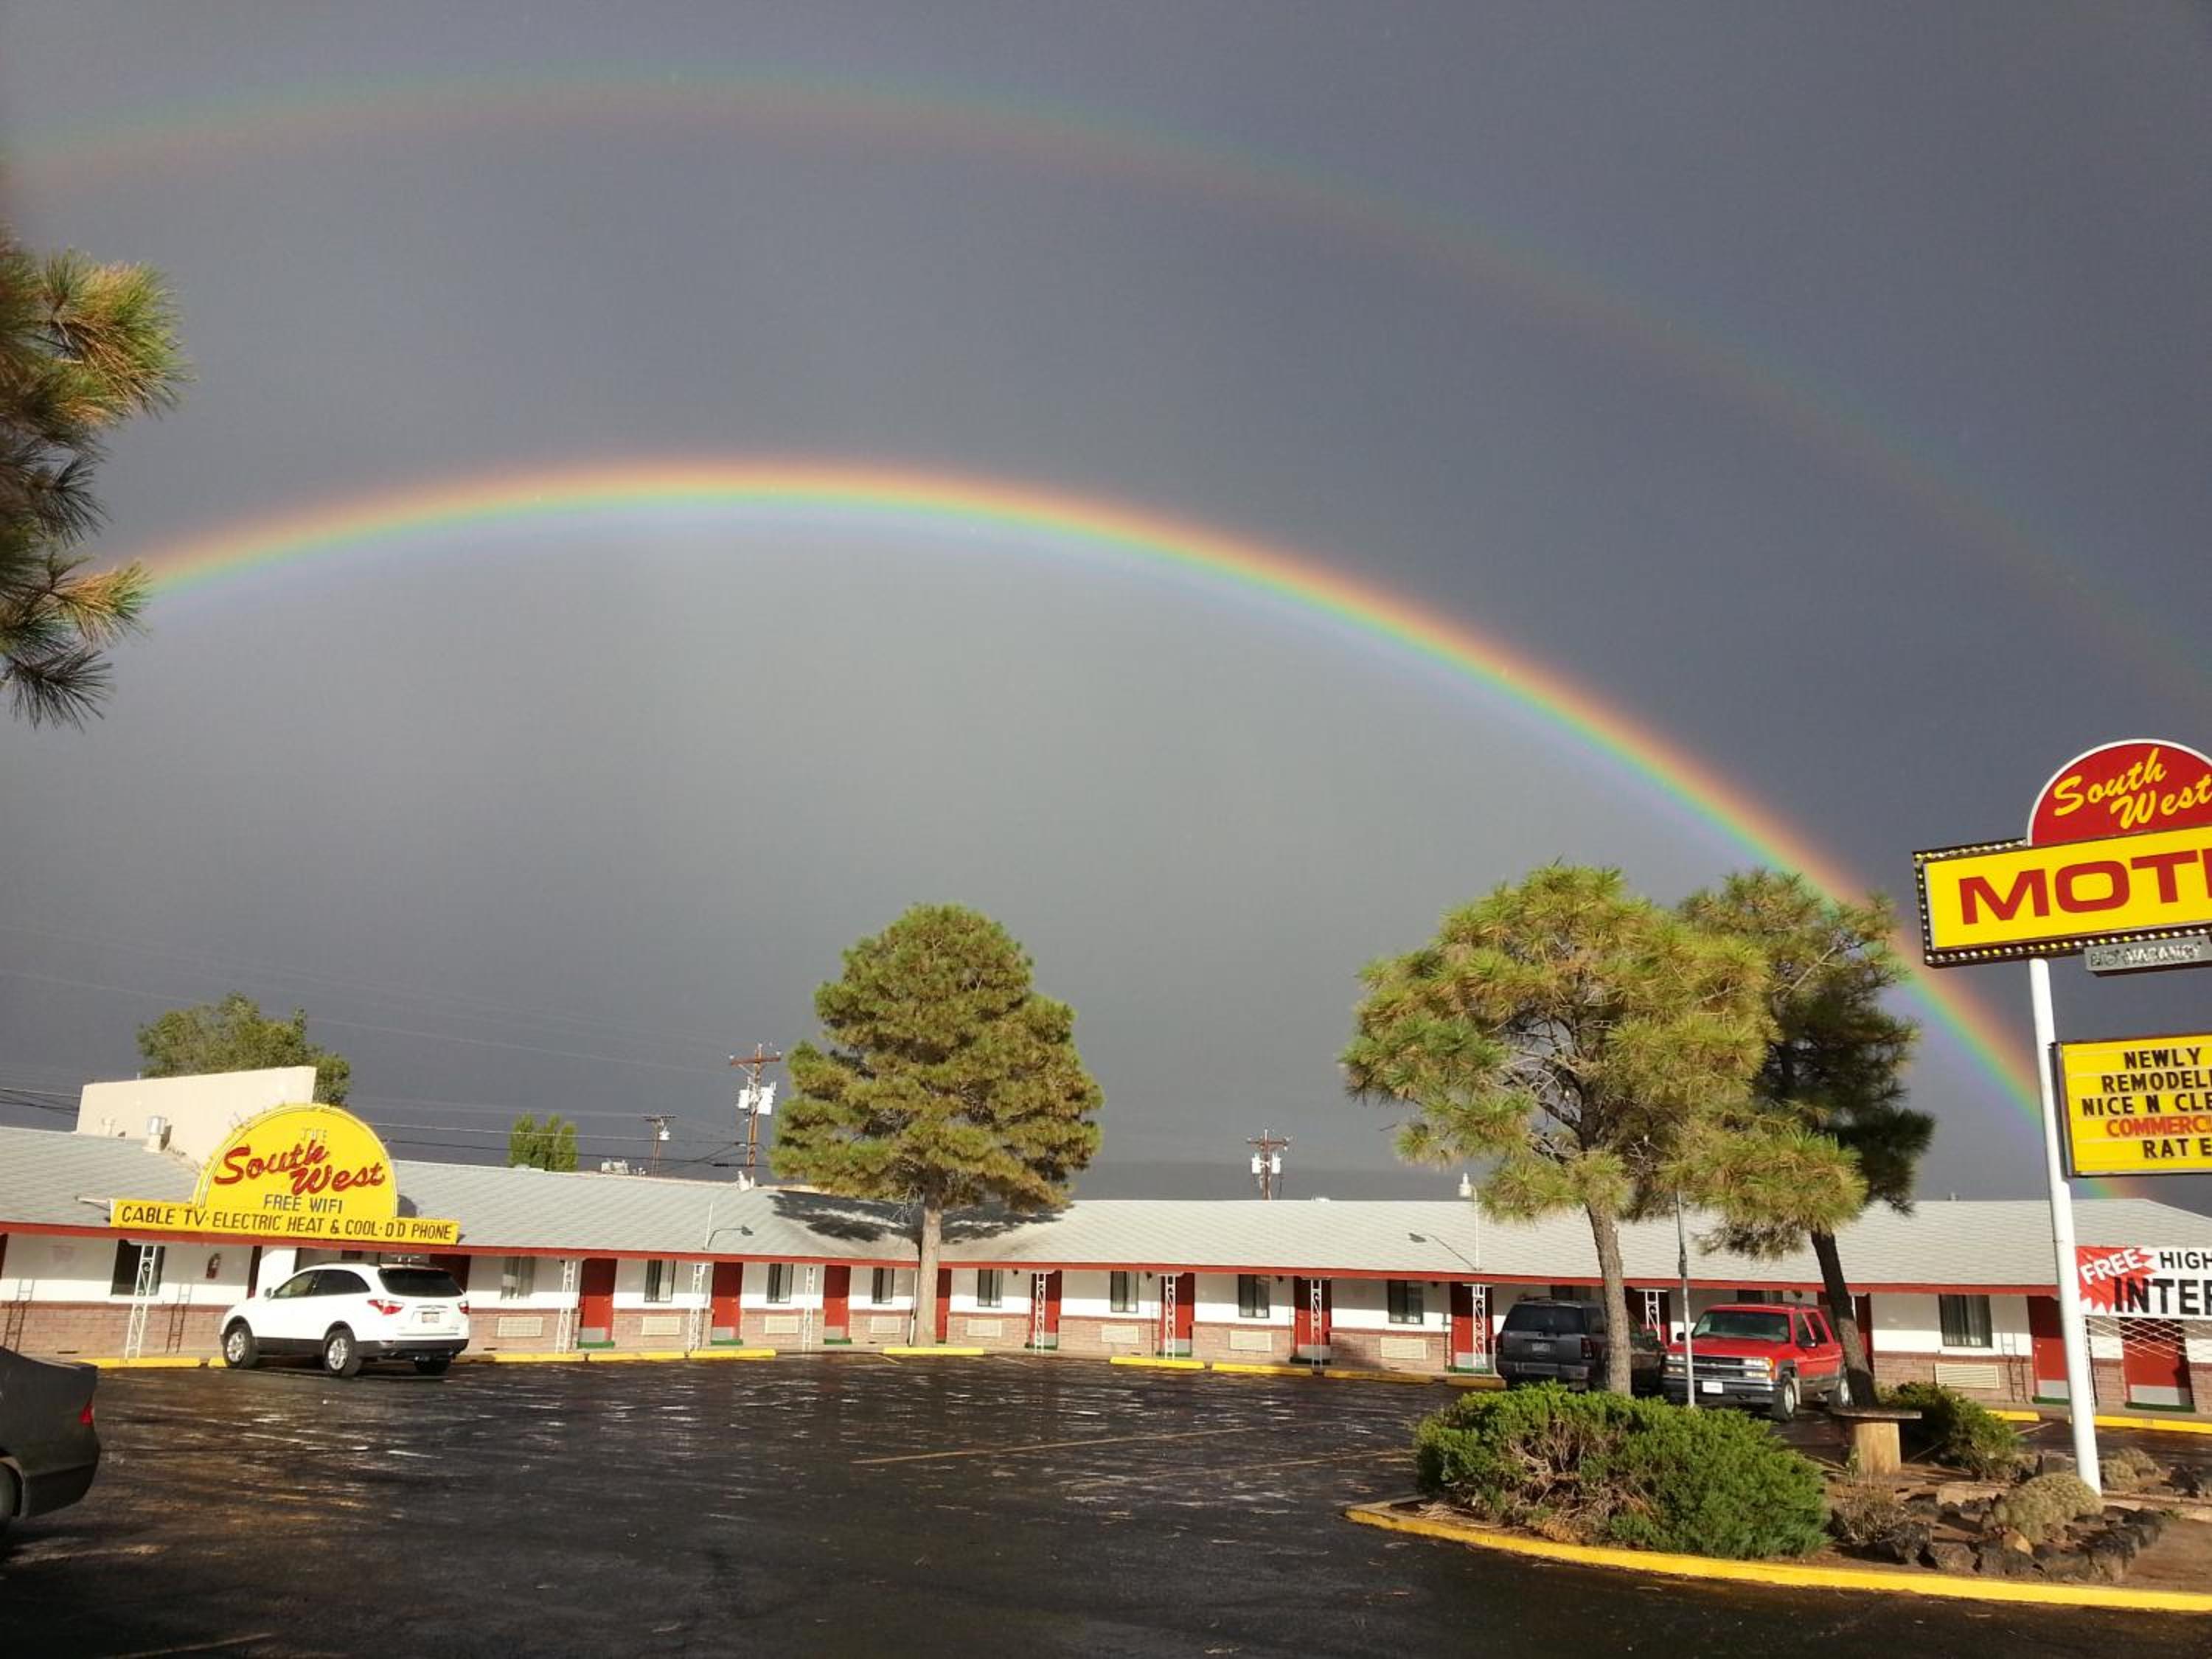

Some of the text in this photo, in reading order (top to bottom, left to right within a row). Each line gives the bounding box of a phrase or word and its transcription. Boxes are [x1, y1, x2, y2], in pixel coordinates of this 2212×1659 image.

[2053, 748, 2166, 817] South
[2110, 774, 2212, 830] West
[1958, 849, 2212, 925] MOT
[2124, 1047, 2201, 1069] NEWLY
[2101, 1070, 2212, 1093] REMODEL
[2081, 1096, 2135, 1116] NICE
[2146, 1095, 2160, 1113] N
[214, 1139, 330, 1185] South
[2142, 1138, 2212, 1159] RATE
[289, 1162, 386, 1196] West
[263, 1194, 343, 1214] FREE WIFI
[122, 1206, 175, 1225] CABLE
[286, 1217, 324, 1233] HEAT
[330, 1219, 340, 1234] &
[411, 1223, 451, 1239] PHONE
[2079, 1248, 2212, 1285] FREE HIGH
